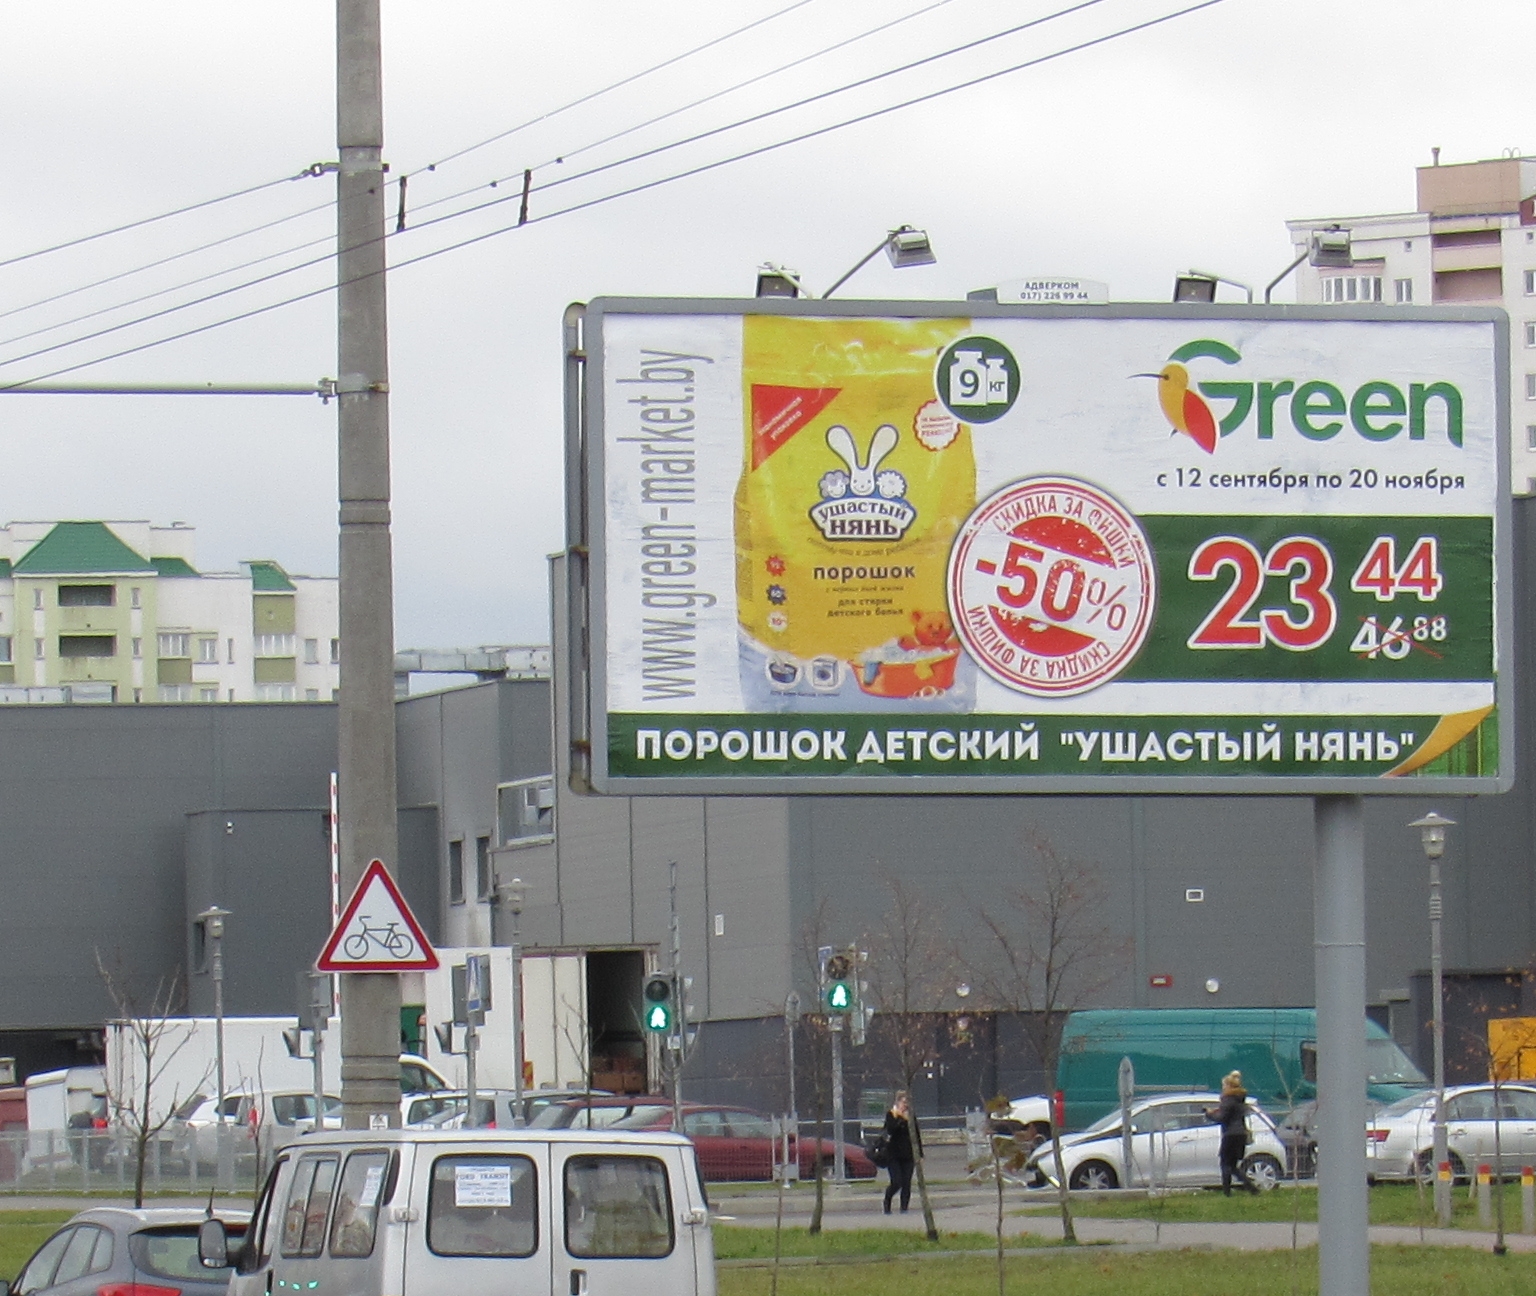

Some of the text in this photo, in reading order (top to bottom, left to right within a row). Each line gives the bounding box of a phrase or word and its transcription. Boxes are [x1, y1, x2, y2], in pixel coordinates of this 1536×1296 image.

[1025, 282, 1080, 290] АДВЕРКОМ
[959, 369, 980, 398] 9
[1160, 338, 1464, 449] Green
[1175, 468, 1202, 488] 12
[1209, 467, 1308, 493] сентября
[1315, 473, 1342, 488] по
[1350, 468, 1378, 489] 20
[1384, 467, 1465, 494] ноября
[615, 349, 717, 702] www.green-market.by
[1063, 496, 1084, 517] ЗА
[1087, 508, 1137, 569] ФИШКИ
[813, 565, 915, 584] порошок
[975, 541, 1128, 631] -50%
[1187, 535, 1443, 651] 23 44
[636, 722, 1414, 764] ПОРОШОК ДЕТСКИЙ "УШАСТЫЙ НЯНЬ"
